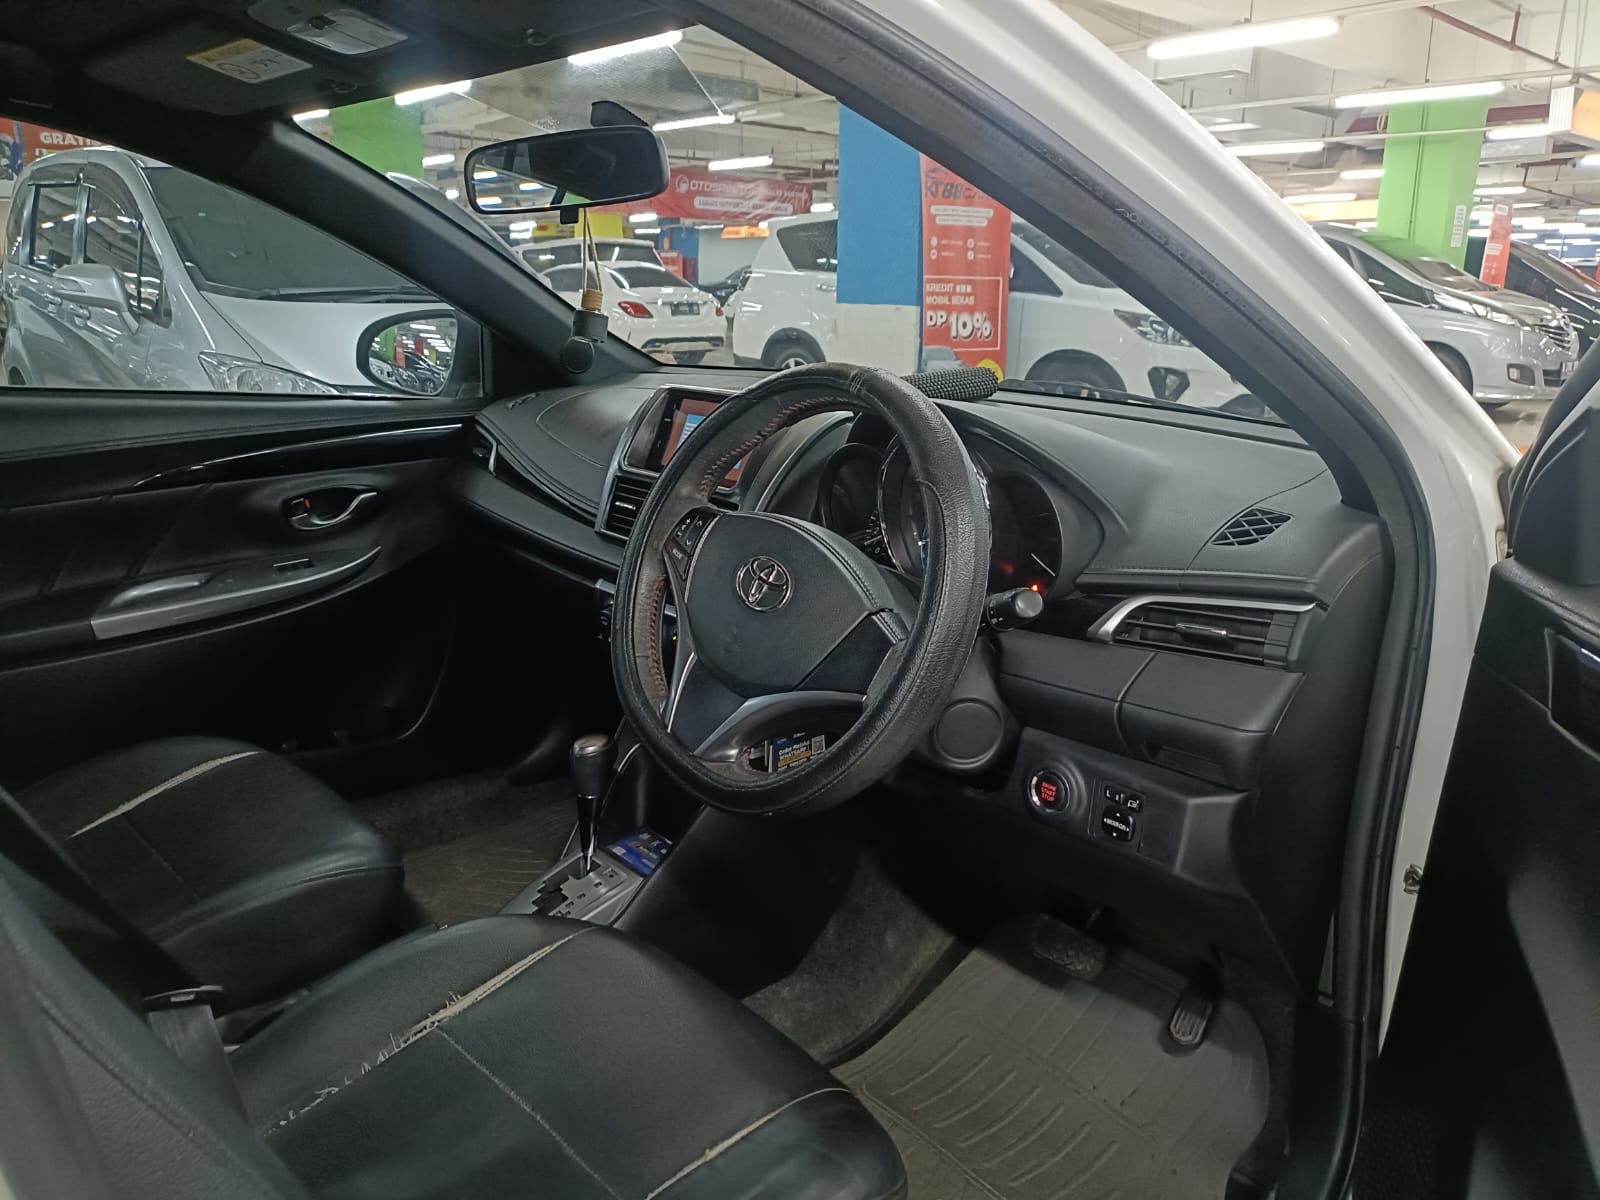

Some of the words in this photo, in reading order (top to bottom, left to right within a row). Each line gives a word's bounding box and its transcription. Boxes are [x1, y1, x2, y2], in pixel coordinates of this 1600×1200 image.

[926, 283, 953, 292] KREDIT
[926, 296, 950, 305] MOBIL
[926, 311, 947, 328] DP
[950, 311, 993, 340] 10%
